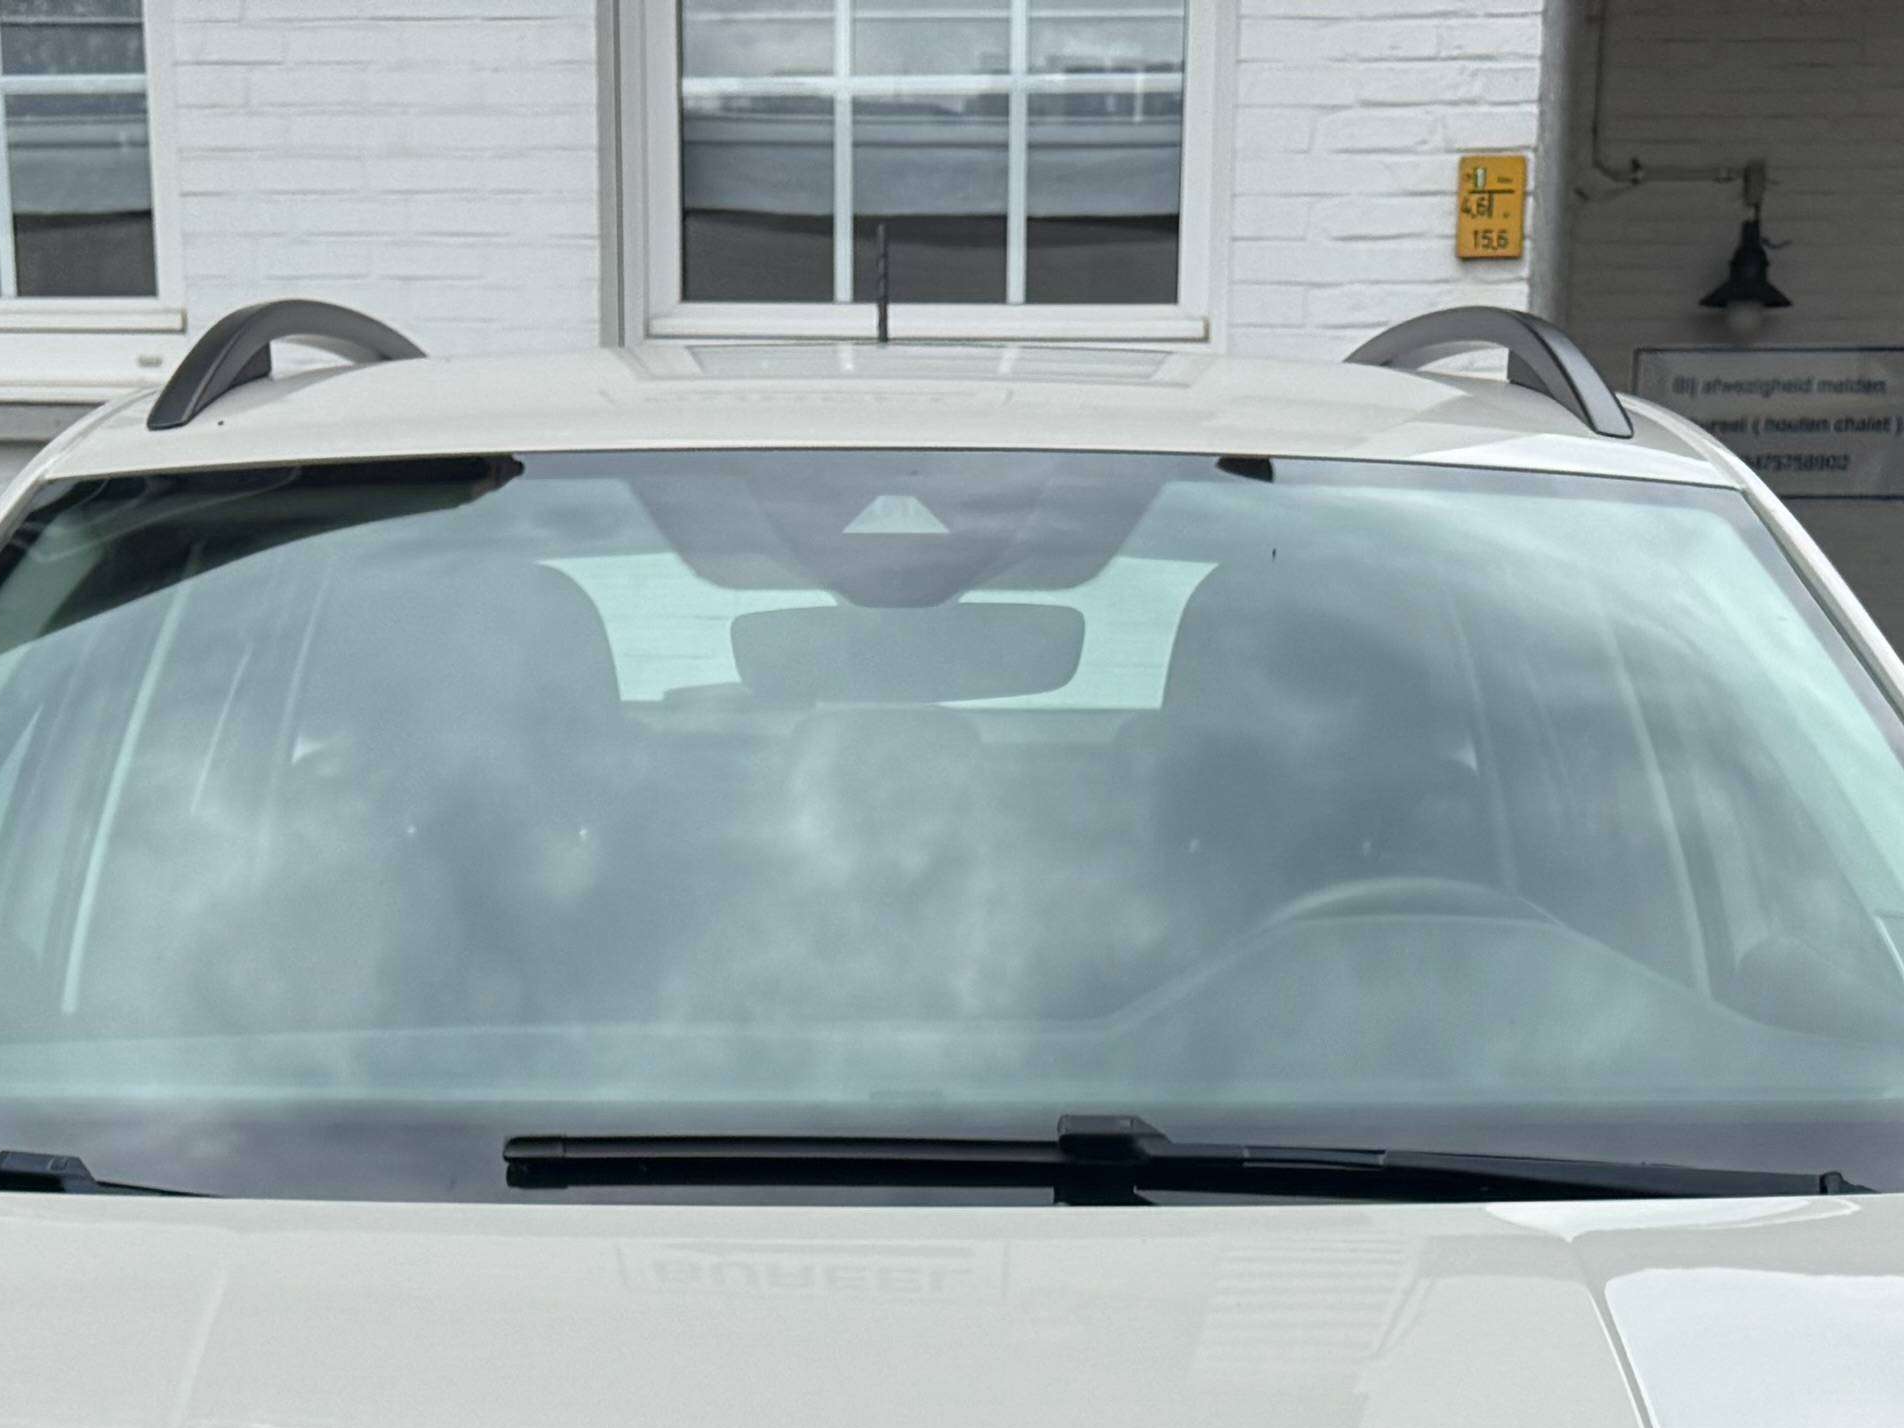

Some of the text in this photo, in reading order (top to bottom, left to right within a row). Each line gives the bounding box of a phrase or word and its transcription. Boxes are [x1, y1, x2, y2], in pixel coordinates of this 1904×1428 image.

[1702, 376, 1814, 398] afwezigheid
[1817, 377, 1887, 394] melden
[1833, 415, 1891, 433] chalet
